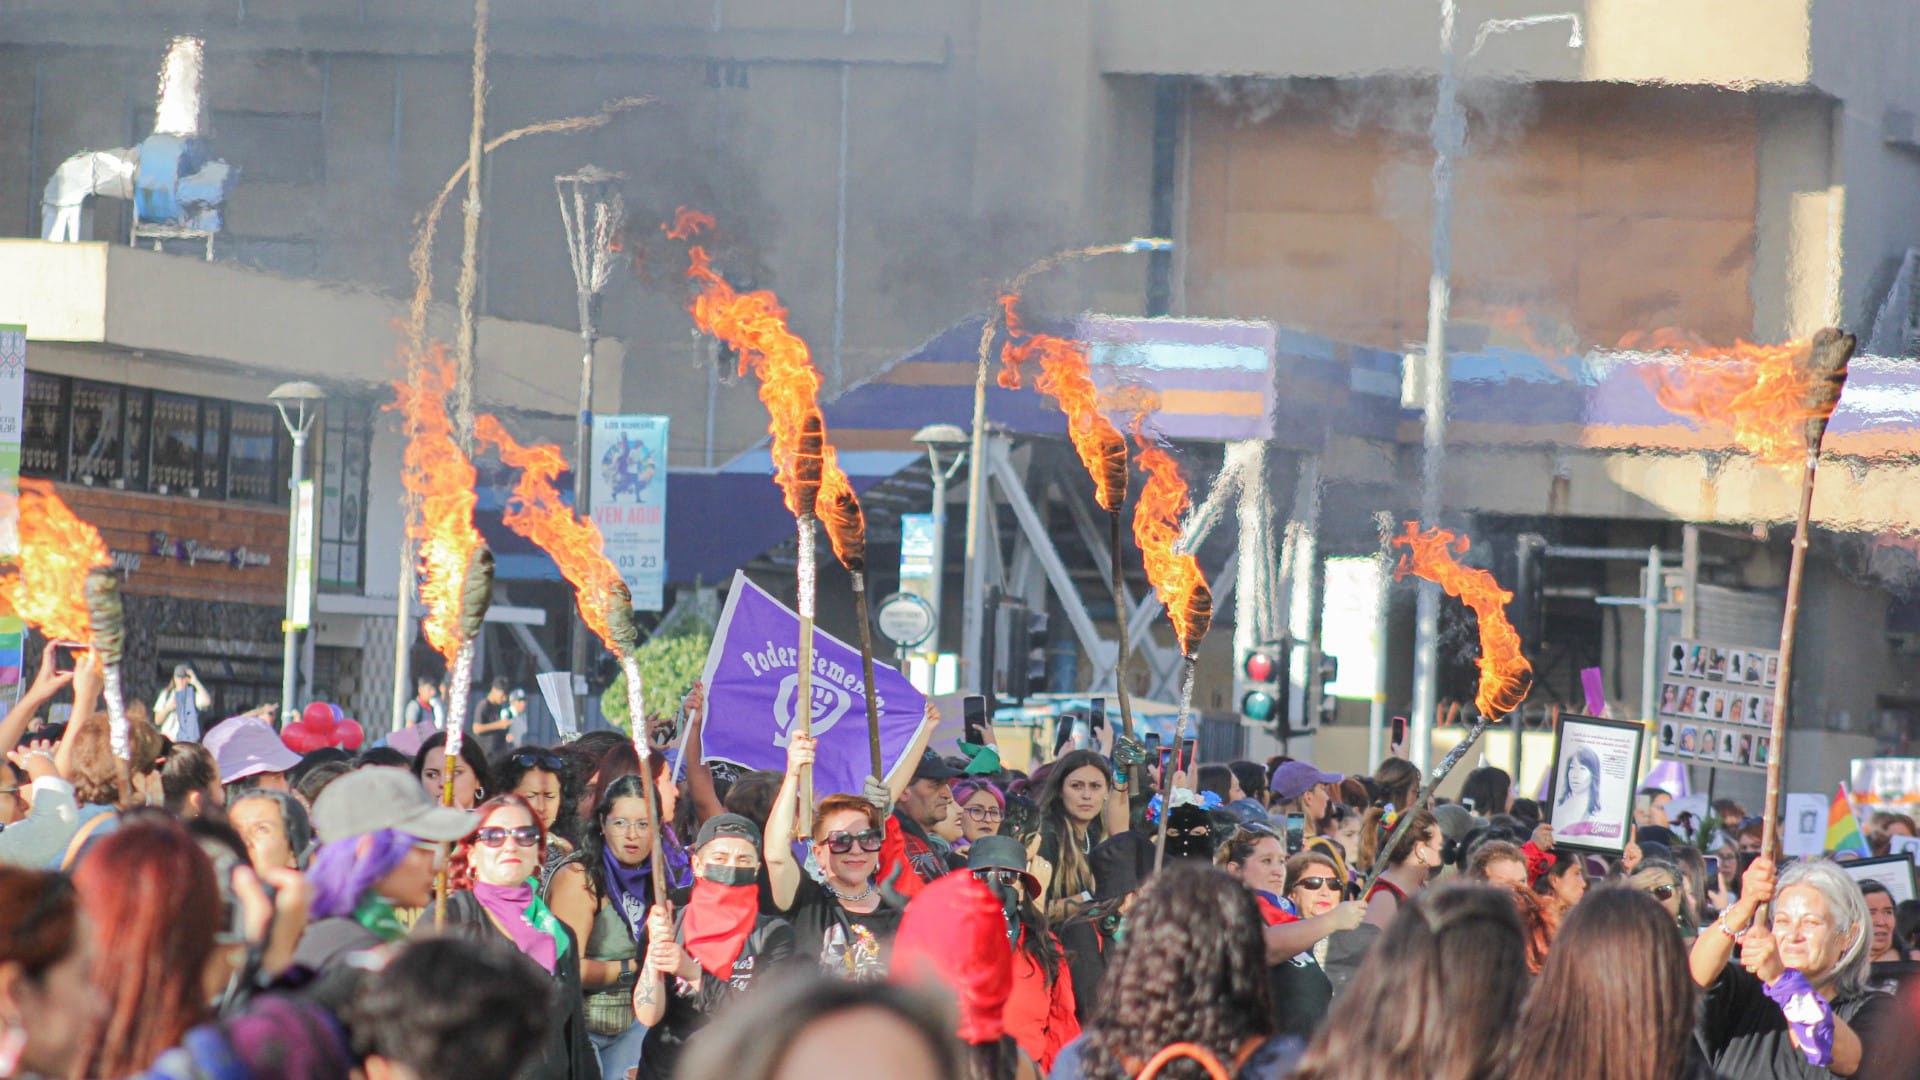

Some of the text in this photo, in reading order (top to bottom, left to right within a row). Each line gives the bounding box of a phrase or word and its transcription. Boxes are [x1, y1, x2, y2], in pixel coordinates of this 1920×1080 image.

[595, 505, 623, 525] VEN
[618, 555, 657, 568] 03 23
[742, 641, 798, 677] Poder
